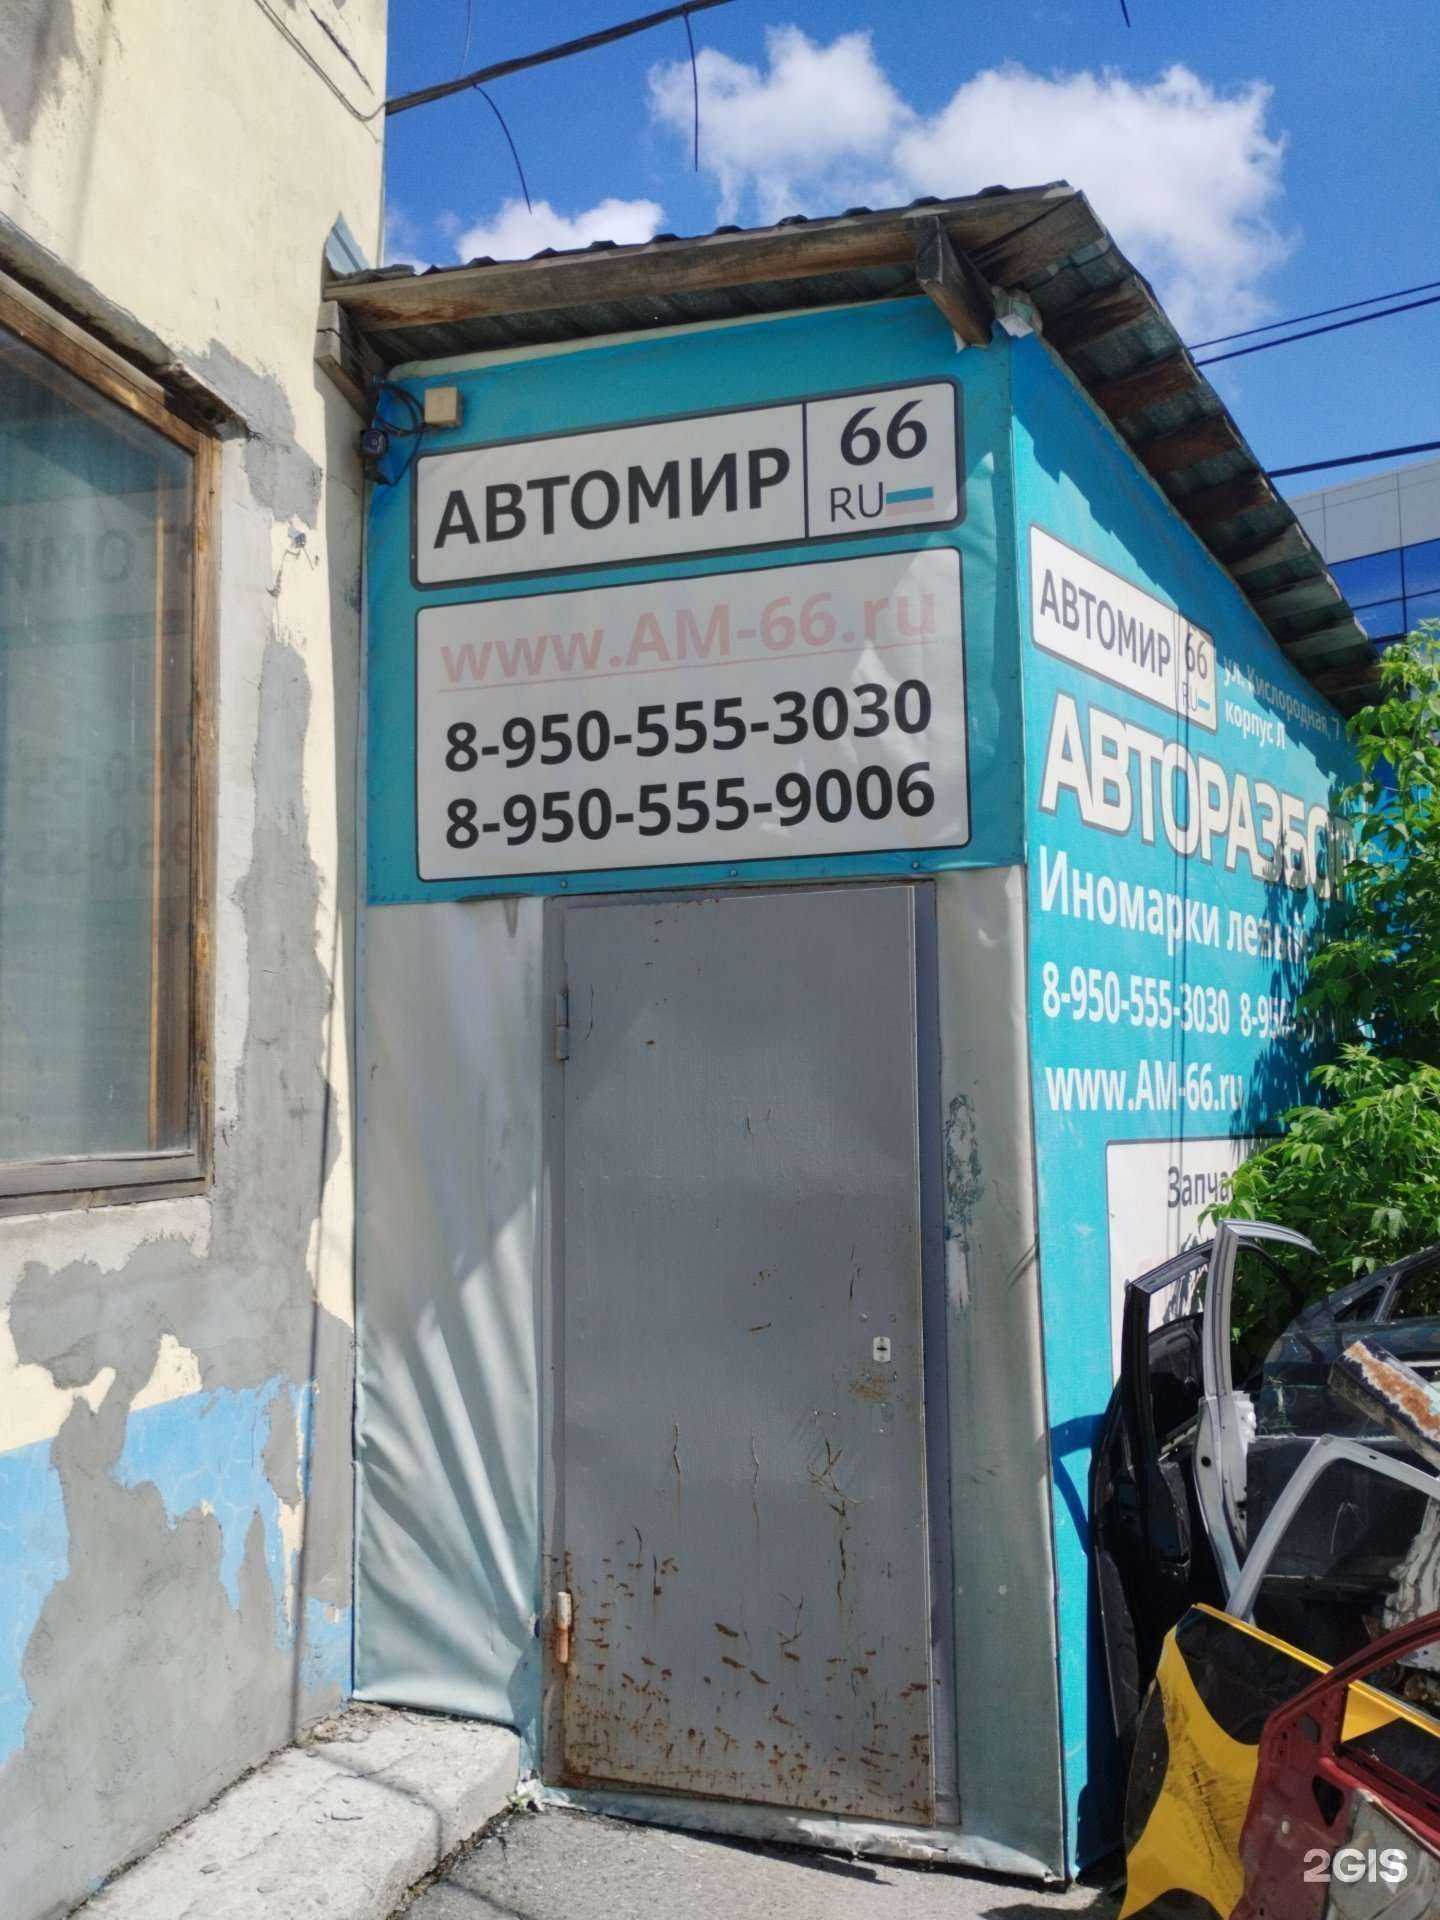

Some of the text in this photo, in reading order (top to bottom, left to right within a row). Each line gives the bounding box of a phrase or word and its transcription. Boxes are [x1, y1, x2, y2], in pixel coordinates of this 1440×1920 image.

[433, 400, 928, 549] АВТОМИР 66
[829, 482, 885, 522] RU
[440, 591, 936, 684] www.AM-66.ru
[1039, 568, 1208, 680] АВТОМИР 66
[444, 678, 933, 773] 8-950-555-3030
[1224, 699, 1274, 748] корпус
[444, 761, 937, 850] 8-950-555-9006
[1039, 845, 1221, 957] Иномарки
[1042, 960, 1231, 1036] 8-950-555-3030
[1045, 1059, 1244, 1113] www.AM-66.ru
